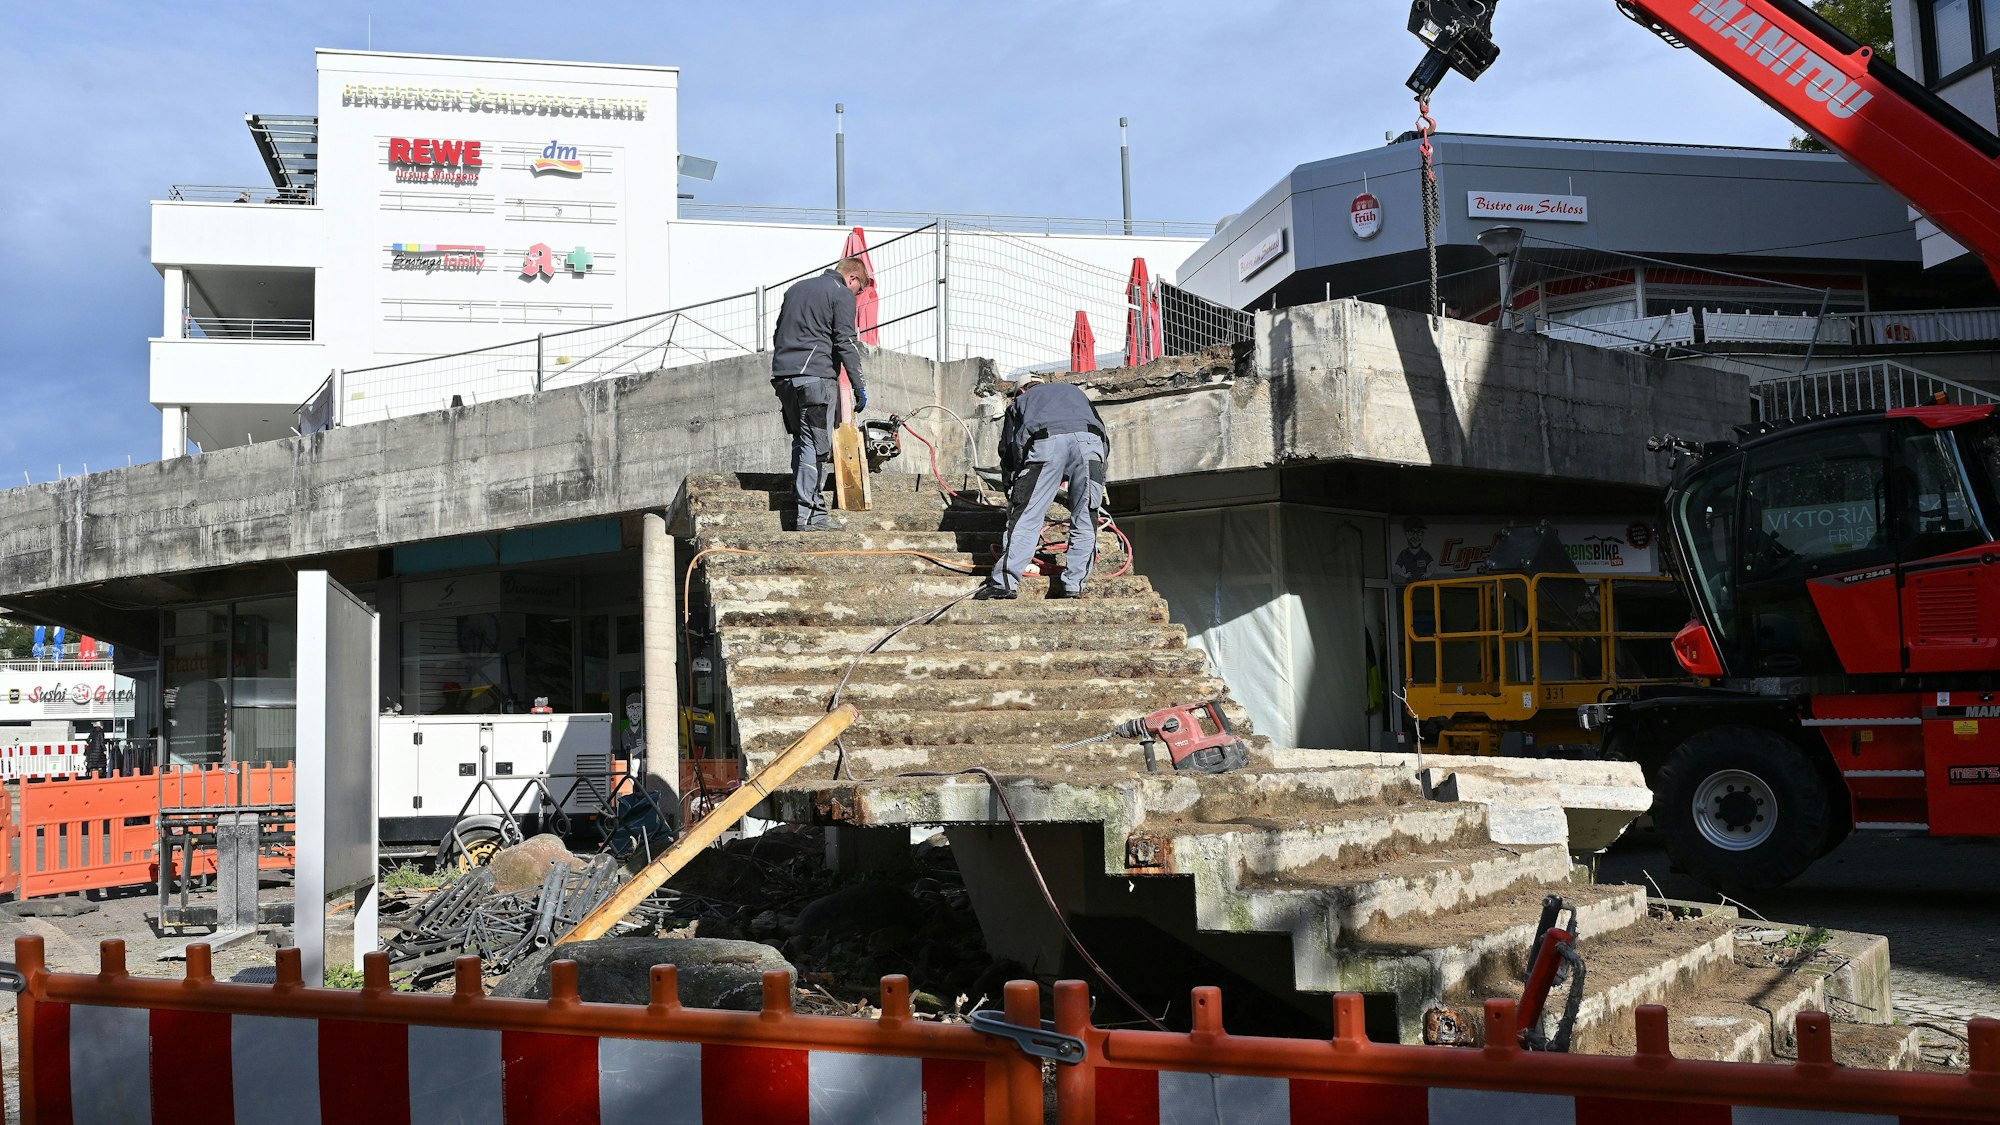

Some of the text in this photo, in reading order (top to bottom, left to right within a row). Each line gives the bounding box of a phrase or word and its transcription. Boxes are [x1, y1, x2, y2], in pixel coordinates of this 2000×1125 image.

[1688, 0, 1875, 119] MANITOU
[389, 137, 482, 167] REWE
[542, 140, 578, 160] dm
[396, 170, 480, 183] Ursula Wintgens
[1473, 197, 1583, 214] Bistro am Schloss
[1355, 211, 1376, 224] früh
[442, 252, 486, 271] family
[1767, 506, 1874, 530] VIKTORIA
[1843, 573, 1865, 583] MRT
[28, 682, 68, 704] Sushi
[1546, 687, 1564, 700] 331
